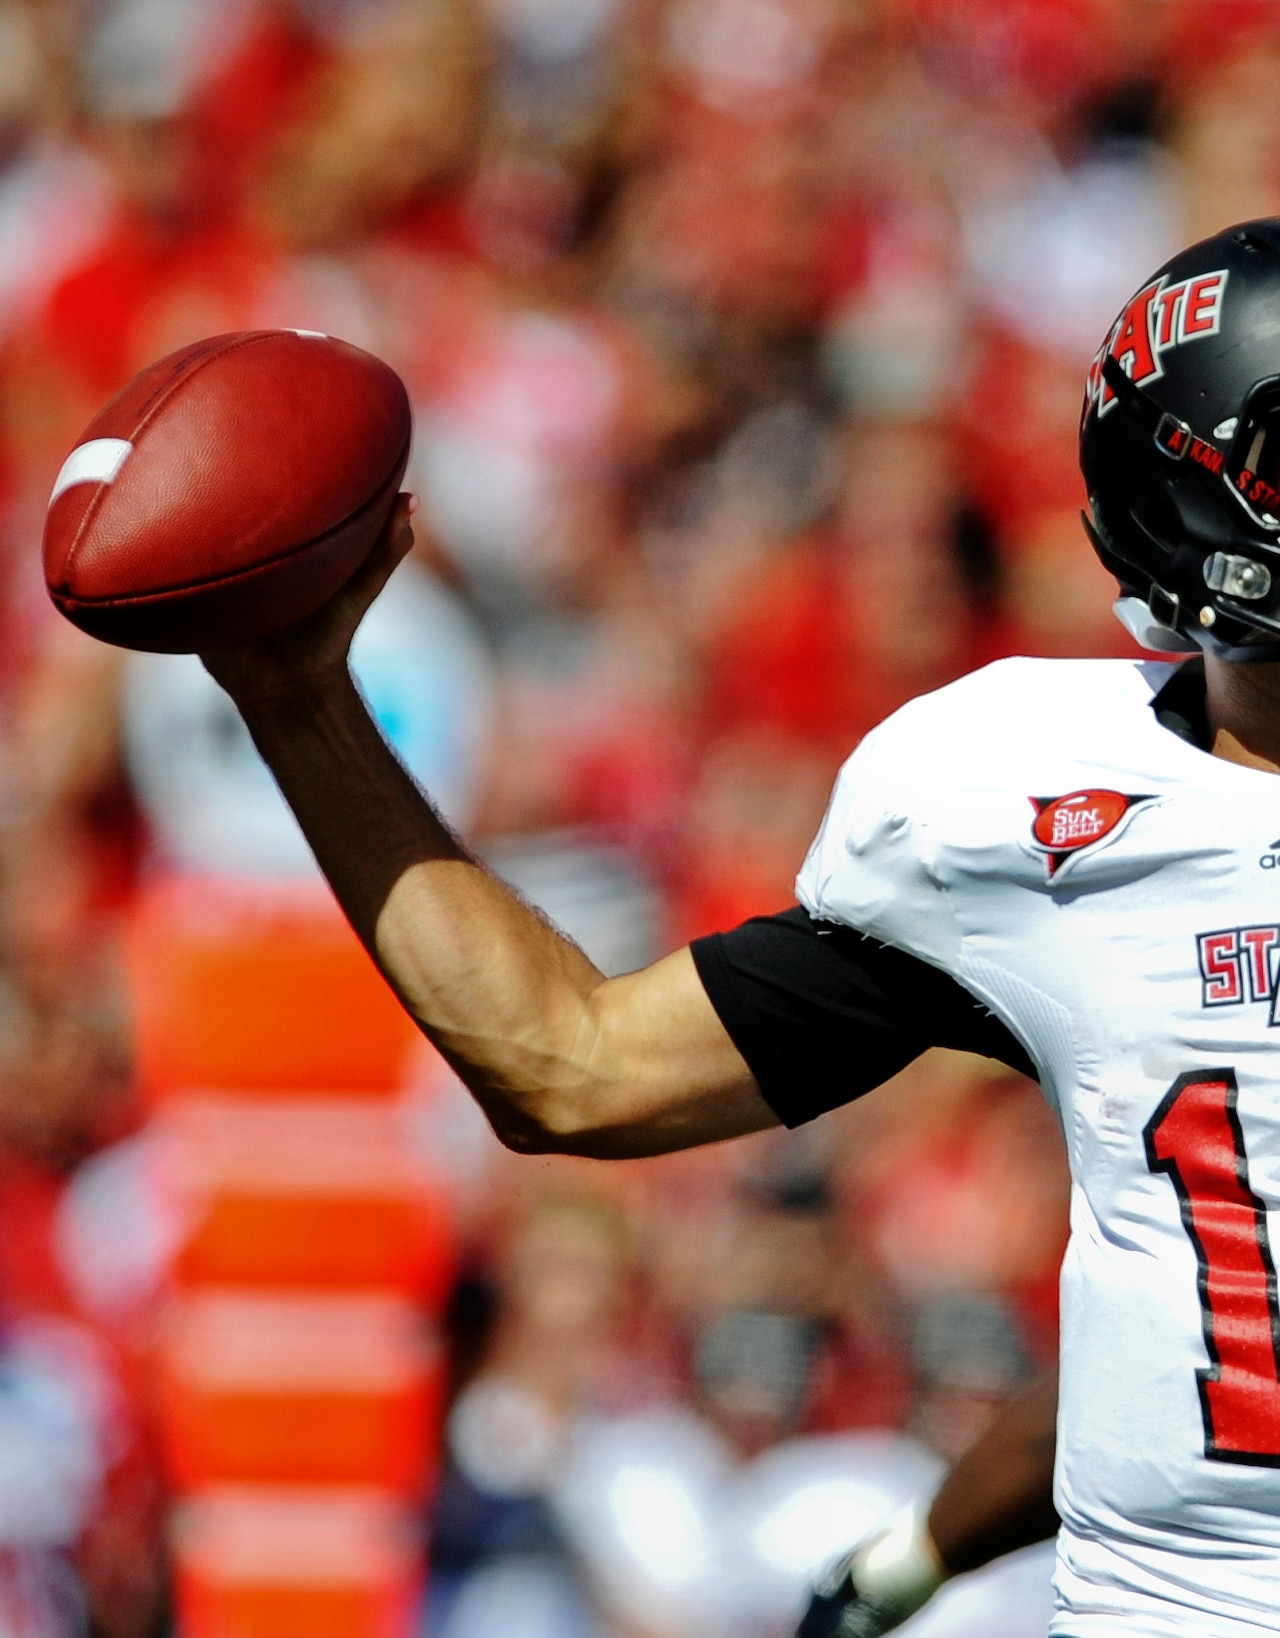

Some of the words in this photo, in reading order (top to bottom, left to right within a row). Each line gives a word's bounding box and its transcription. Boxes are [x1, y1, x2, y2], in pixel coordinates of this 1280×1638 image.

[1167, 428, 1253, 490] AKANS
[1053, 808, 1099, 825] SUN
[1051, 819, 1104, 845] BELT
